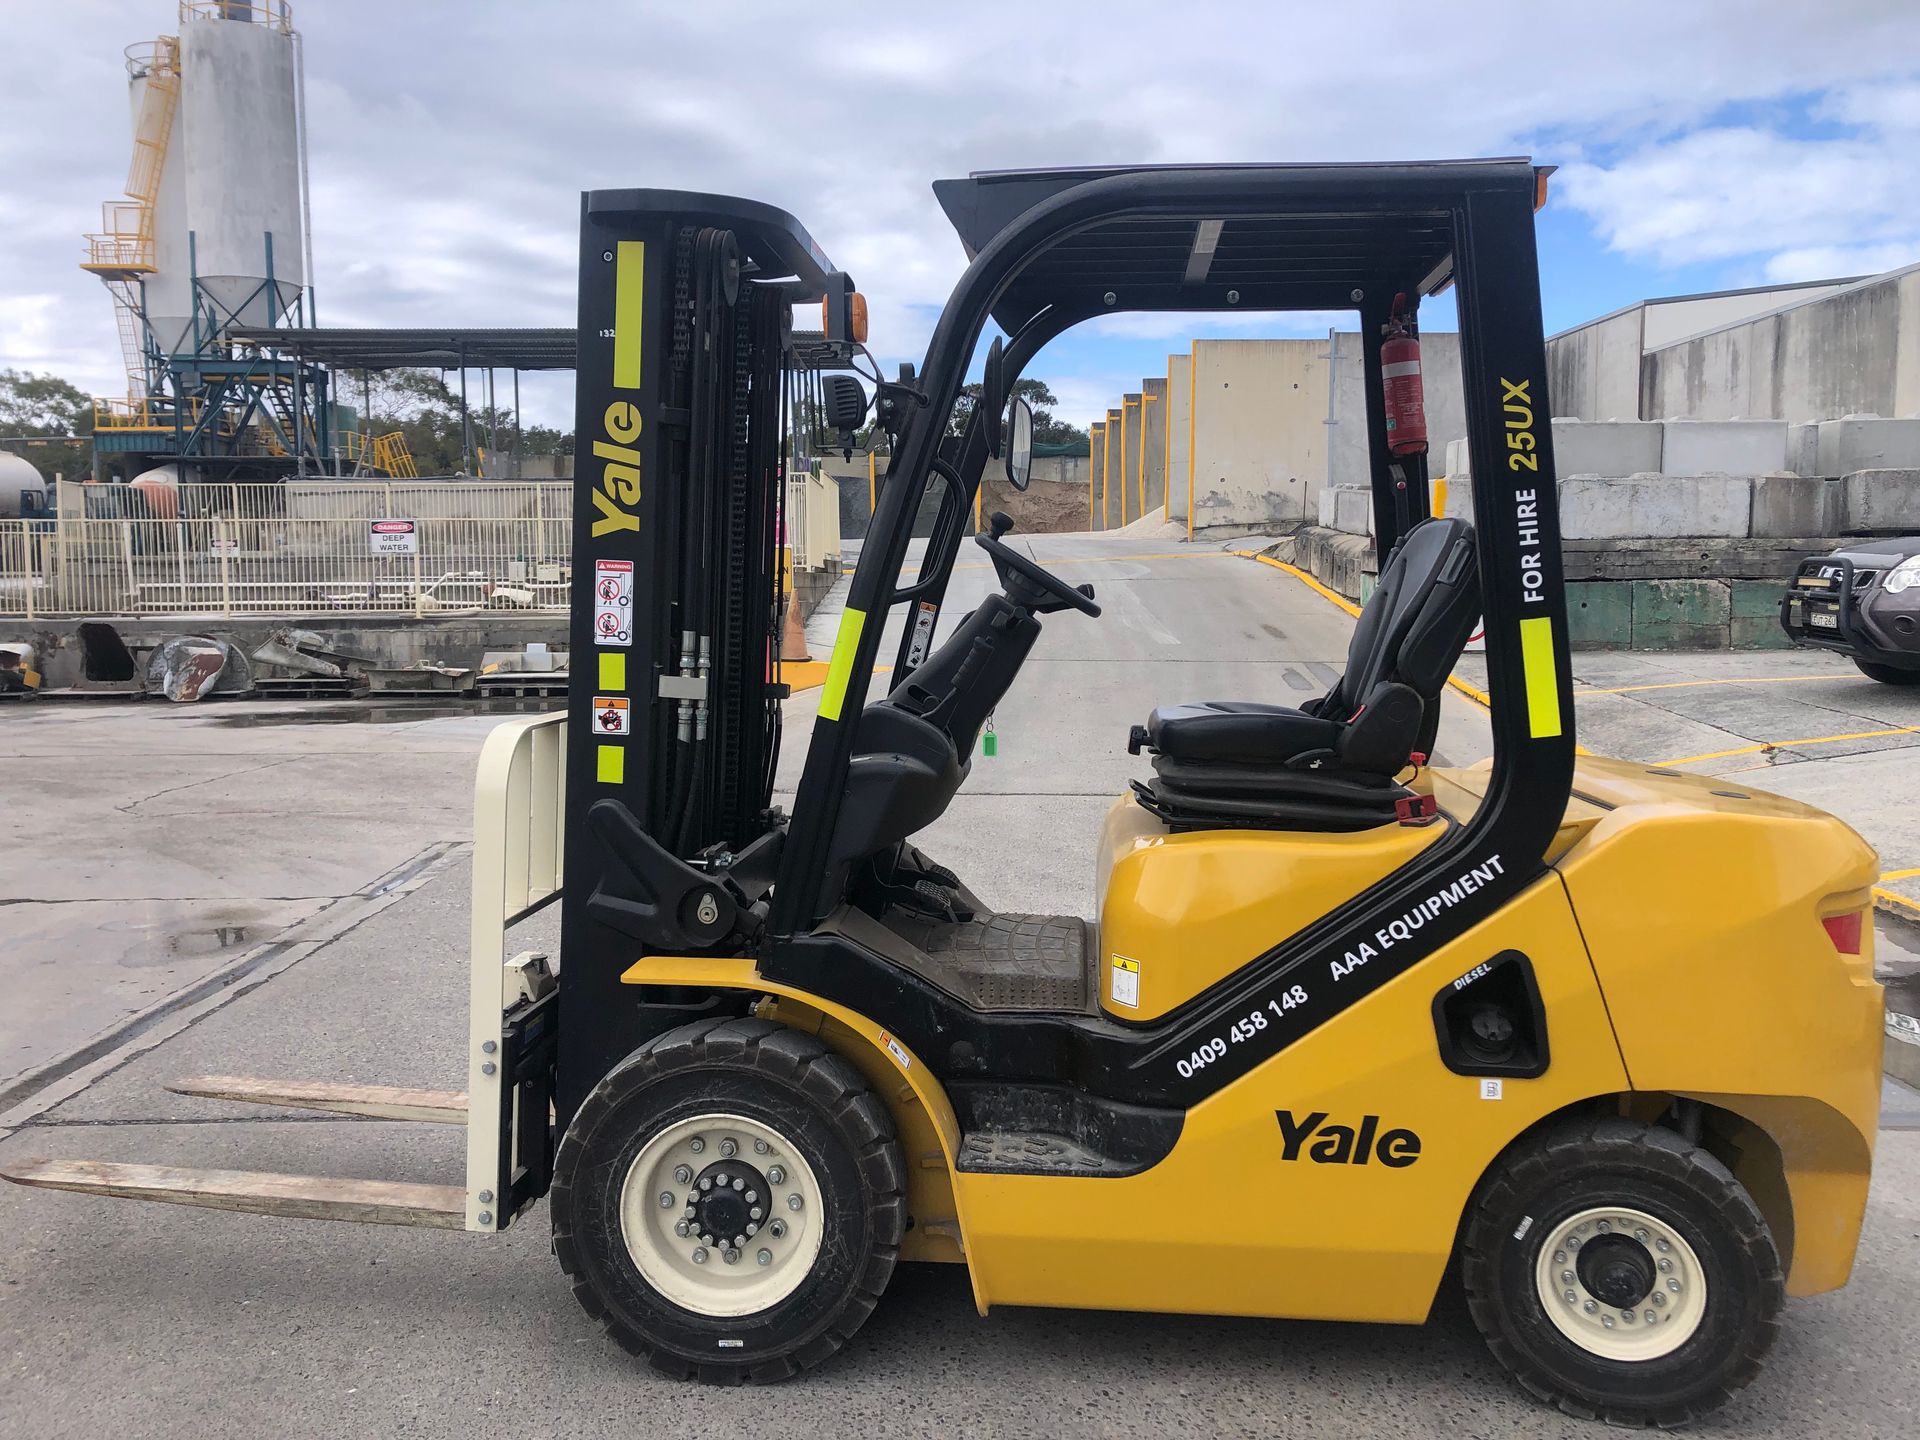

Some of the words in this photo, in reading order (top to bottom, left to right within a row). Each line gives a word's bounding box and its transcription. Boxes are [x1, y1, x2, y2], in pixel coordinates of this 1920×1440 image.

[1500, 376, 1538, 471] 25UX
[591, 401, 642, 538] Yale
[382, 534, 405, 542] DEEP
[1515, 488, 1540, 546] HIRE
[1521, 552, 1545, 602] FOR
[1329, 942, 1379, 981] AAA
[1374, 854, 1505, 949] EQUIPMENT
[1453, 963, 1492, 990] DIESEL
[1176, 1037, 1227, 1078] 0409
[1230, 1011, 1268, 1044] 458
[1268, 985, 1309, 1017] 148
[1274, 1109, 1422, 1168] Yale
